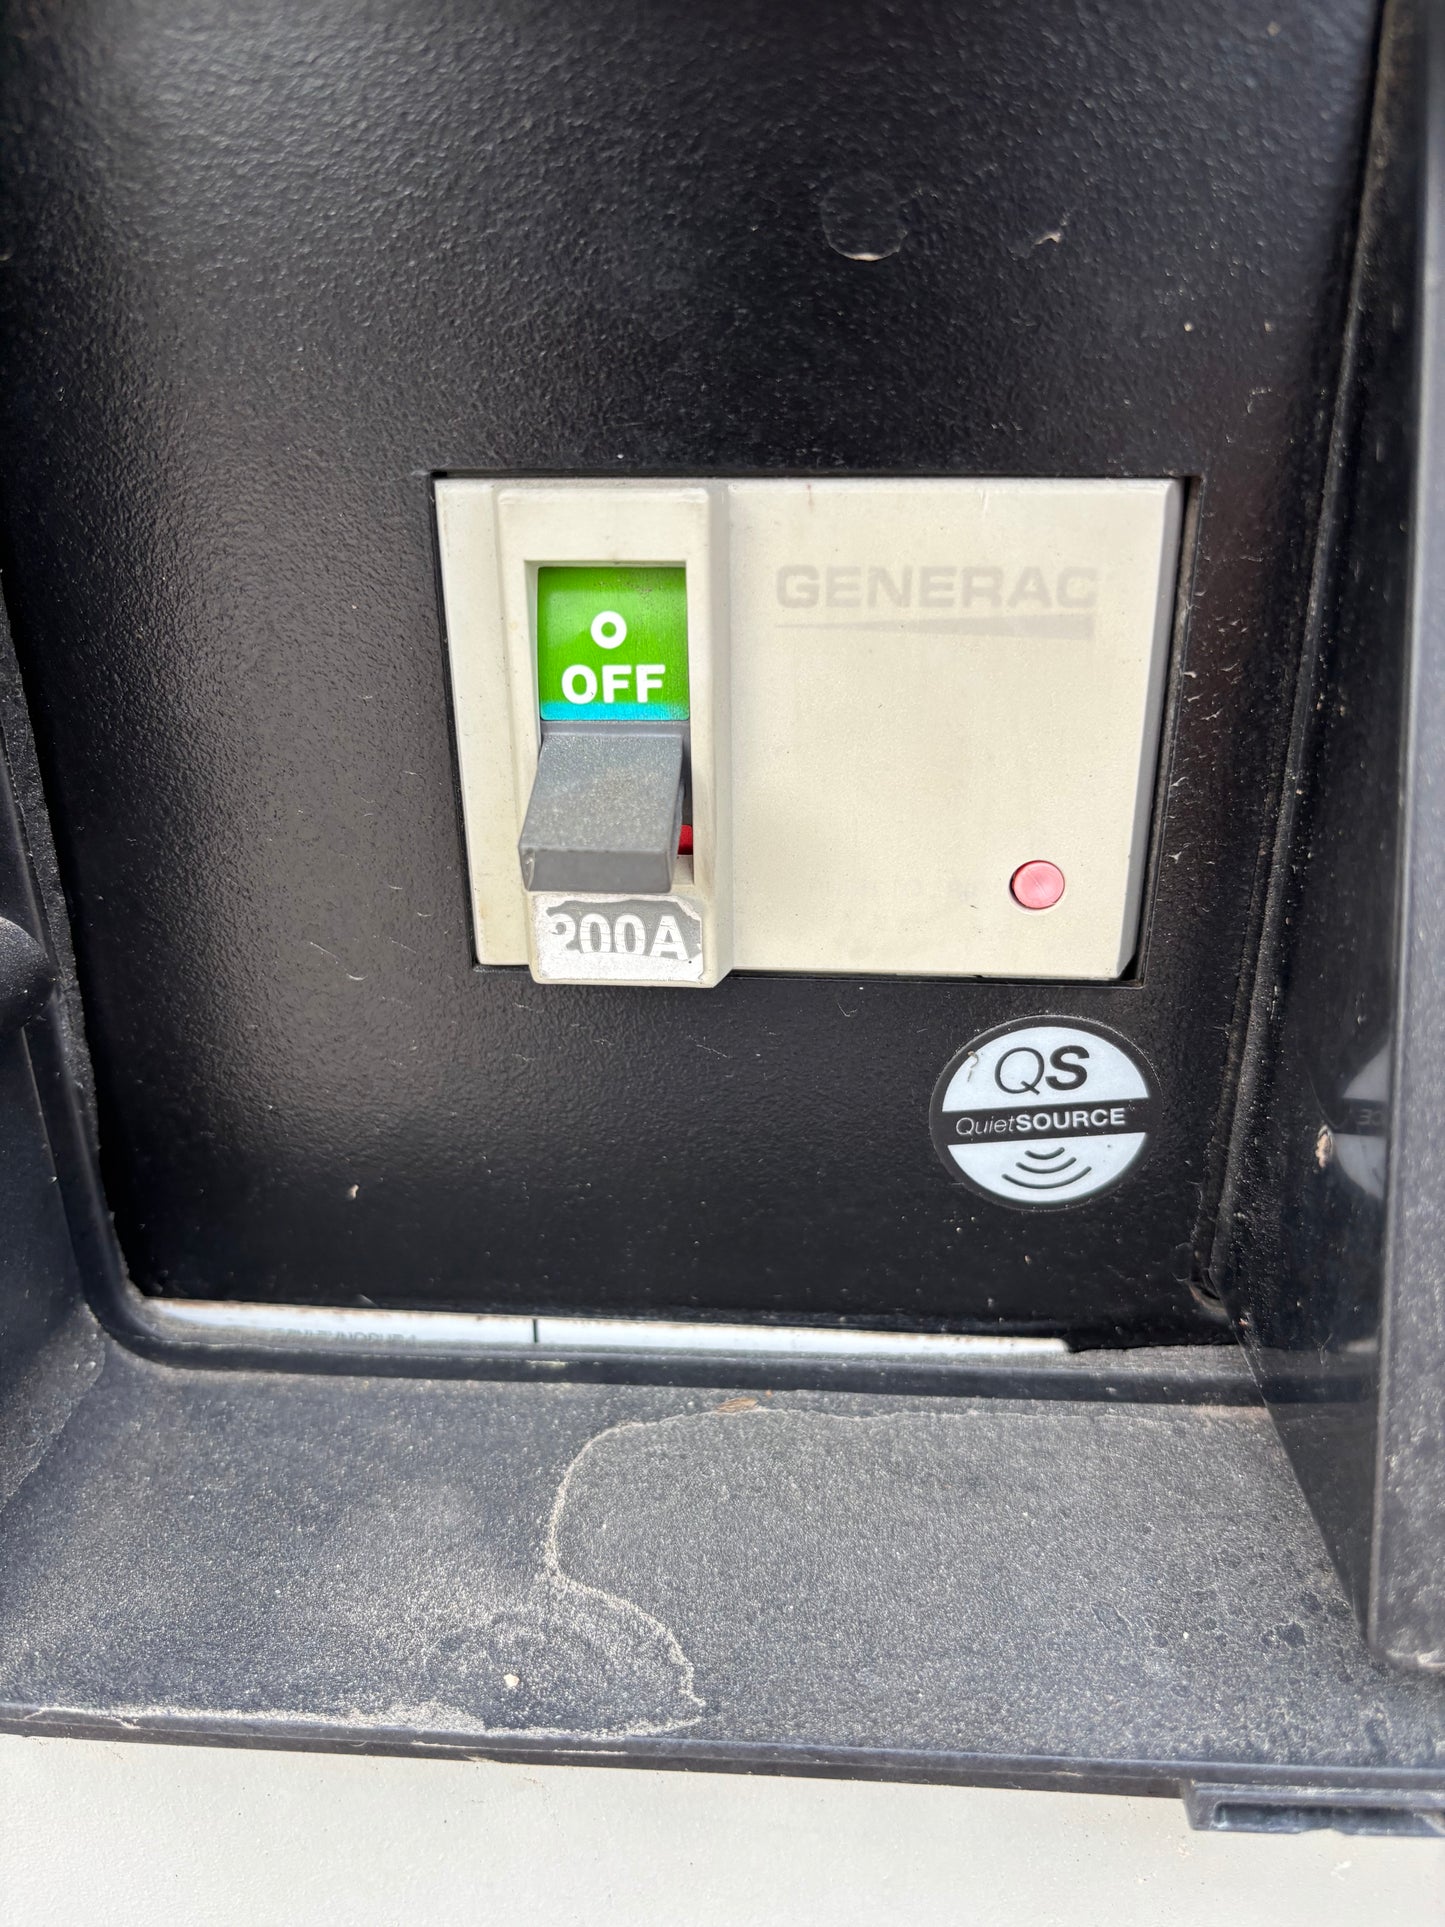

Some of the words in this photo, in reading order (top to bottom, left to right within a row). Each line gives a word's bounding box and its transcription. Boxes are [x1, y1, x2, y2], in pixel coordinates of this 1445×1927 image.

[778, 565, 1098, 608] GENERAC
[561, 664, 666, 704] OFF
[994, 1044, 1090, 1096] QS
